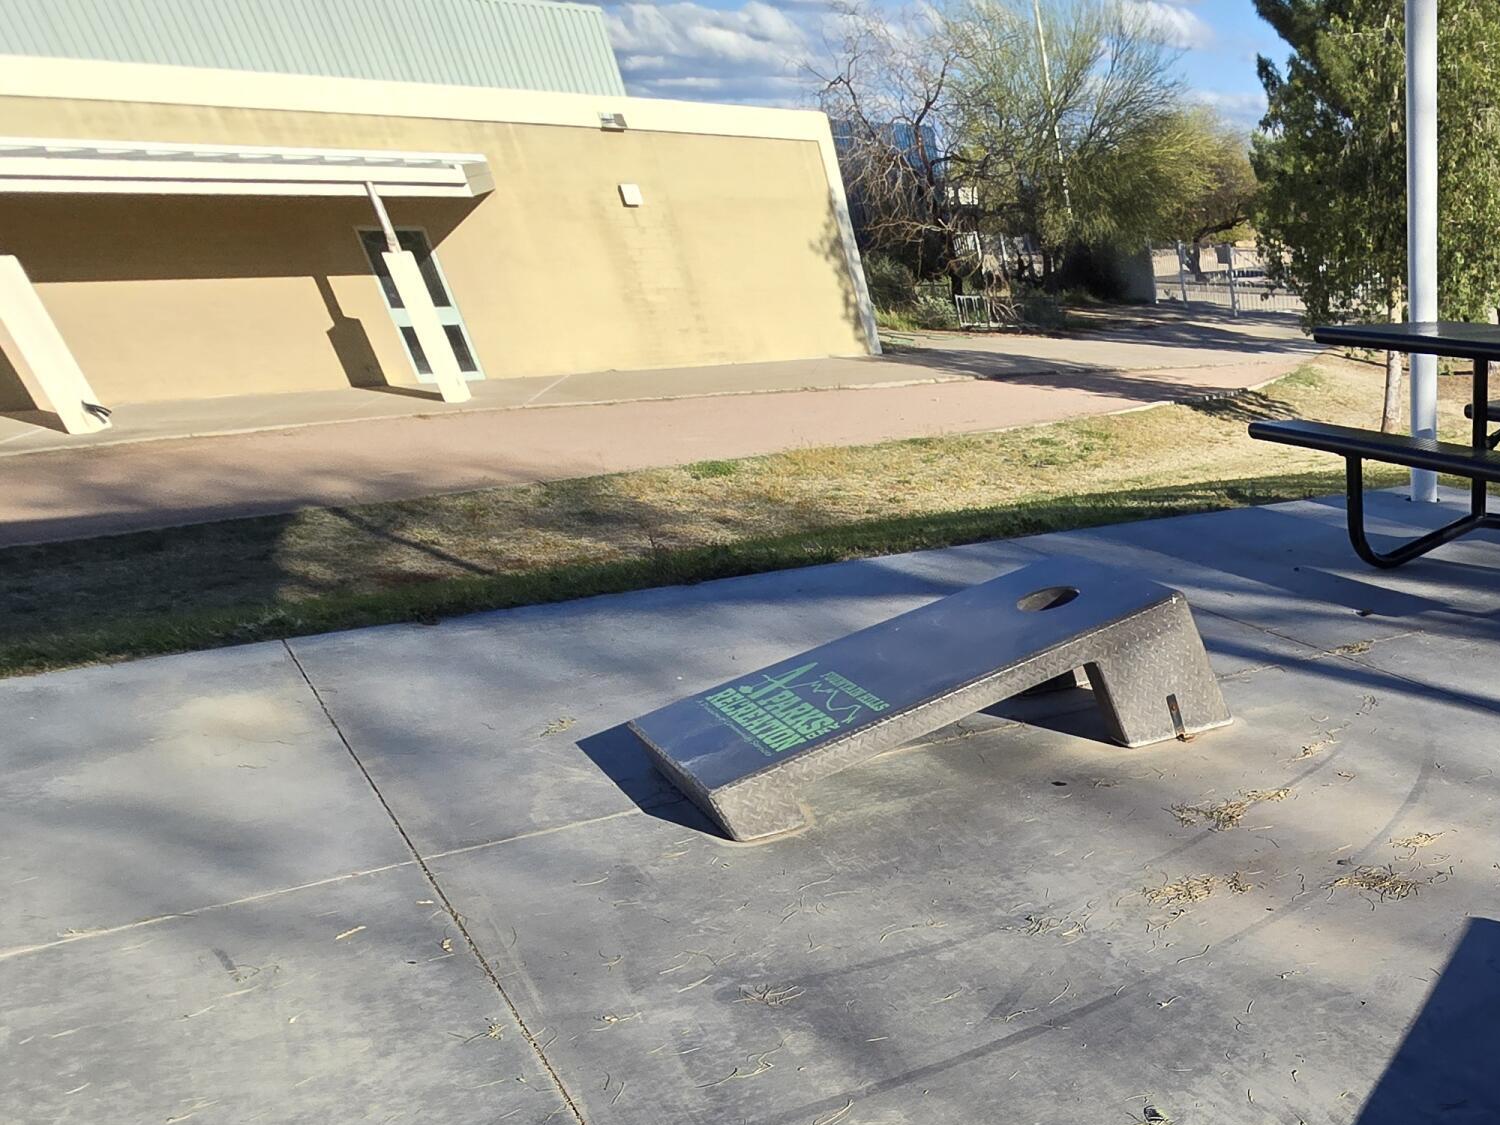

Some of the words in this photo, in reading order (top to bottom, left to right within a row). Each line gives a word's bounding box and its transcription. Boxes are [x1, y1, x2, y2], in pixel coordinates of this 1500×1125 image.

[705, 687, 807, 752] RECREATION
[756, 689, 835, 735] PARKS
[805, 721, 840, 740] AND
